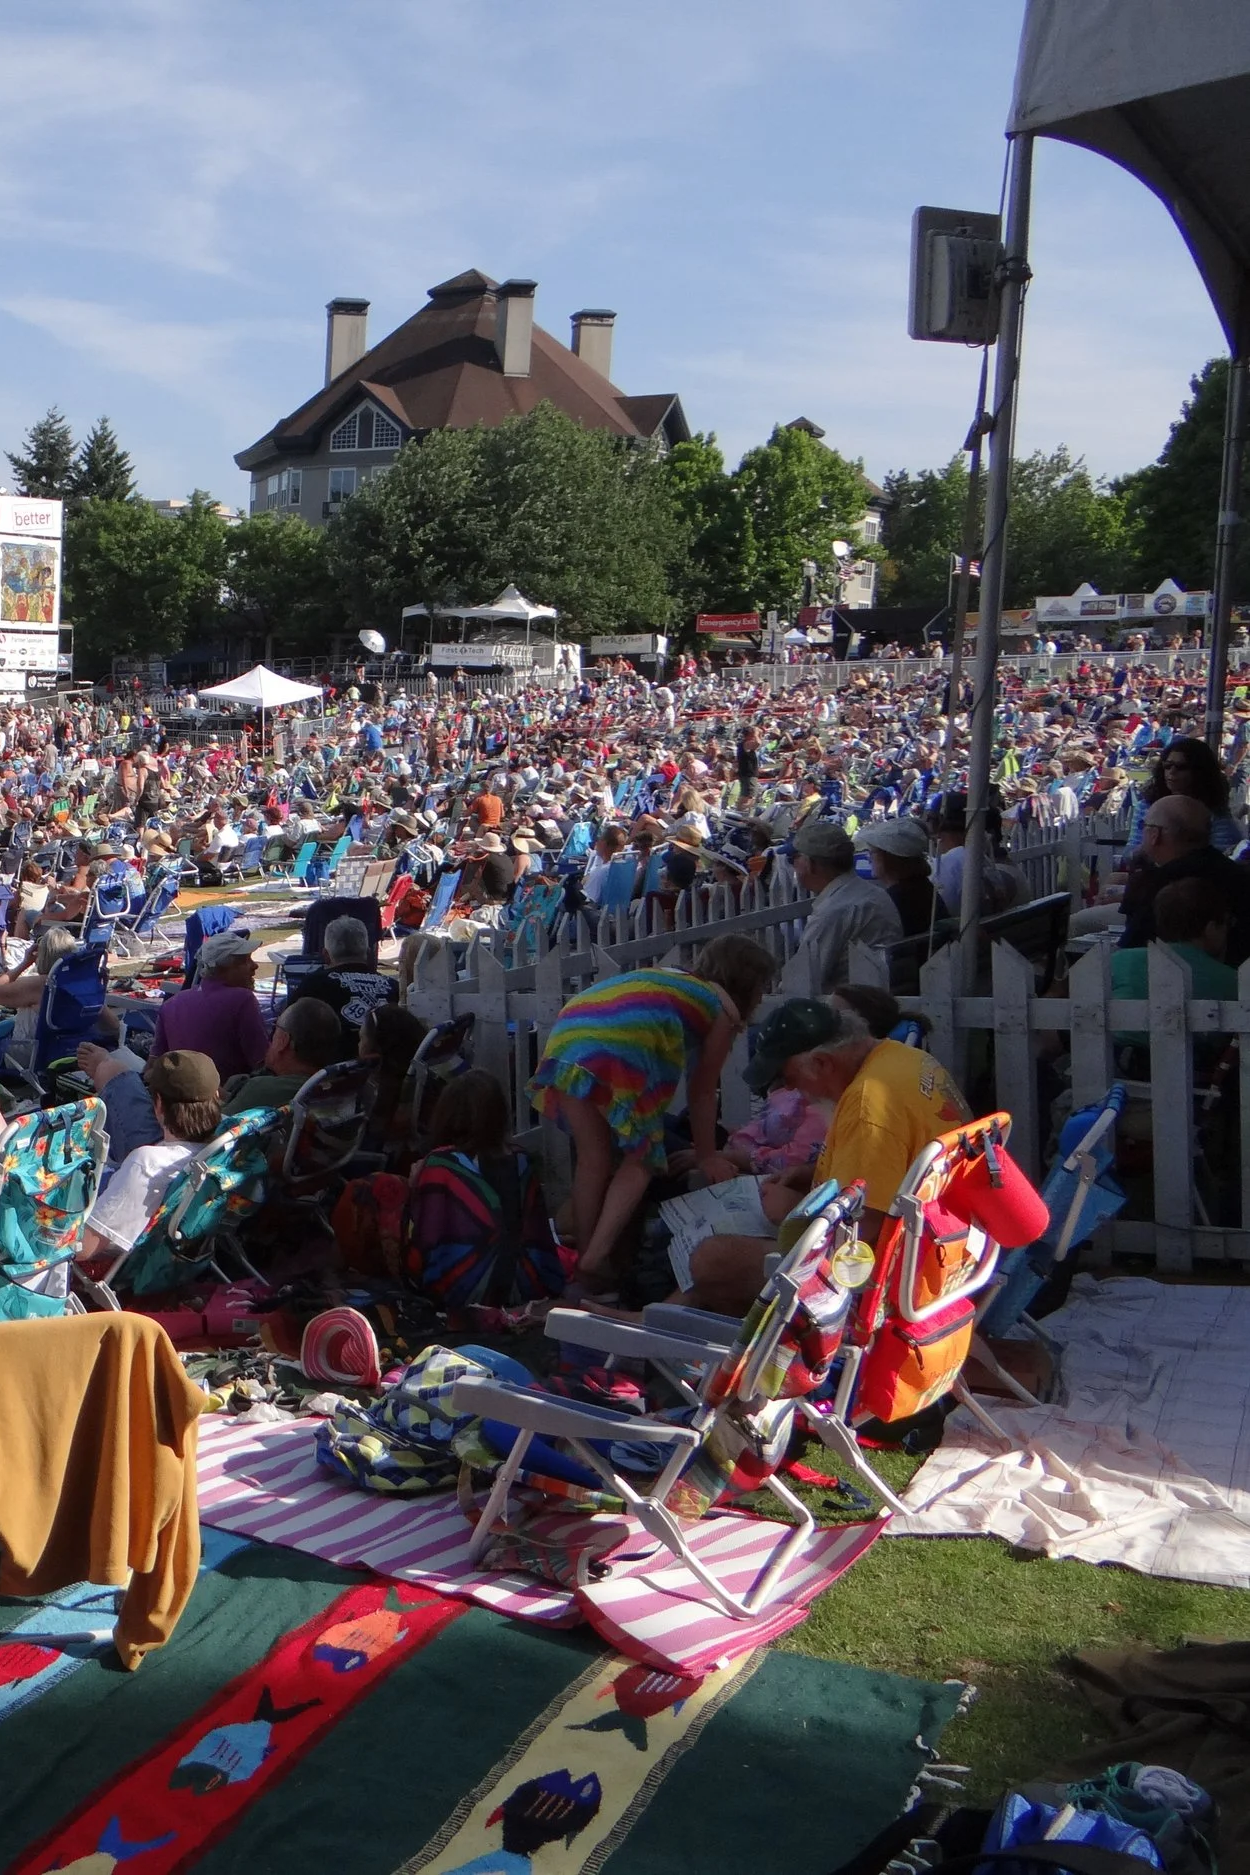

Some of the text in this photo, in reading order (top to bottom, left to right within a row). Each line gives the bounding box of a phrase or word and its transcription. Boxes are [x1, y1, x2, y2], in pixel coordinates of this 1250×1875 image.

[14, 511, 51, 526] better
[699, 617, 757, 627] Emergency Exit
[348, 1003, 366, 1018] 49
